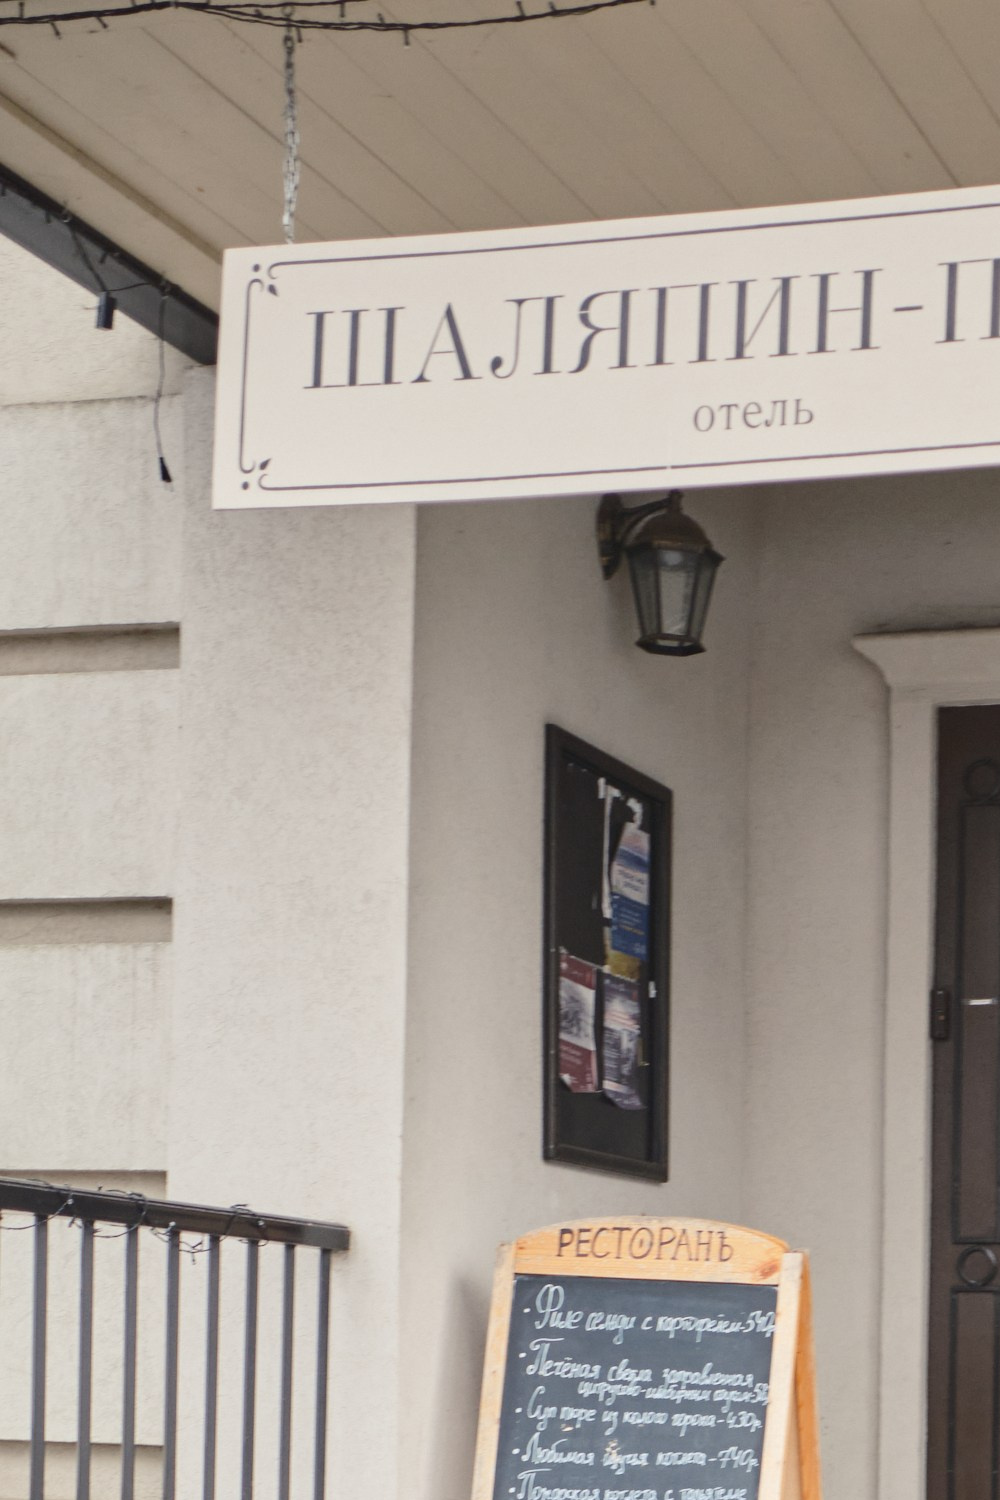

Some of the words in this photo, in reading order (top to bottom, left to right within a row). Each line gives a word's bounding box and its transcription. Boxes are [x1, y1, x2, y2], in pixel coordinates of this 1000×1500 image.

[691, 394, 815, 434] отель
[555, 1226, 735, 1263] РЕСТОРАНЪ
[534, 1284, 584, 1329] Филе
[641, 1315, 653, 1330] с
[526, 1385, 558, 1431] Суп
[601, 1410, 620, 1436] из
[520, 1431, 595, 1466] Любимая
